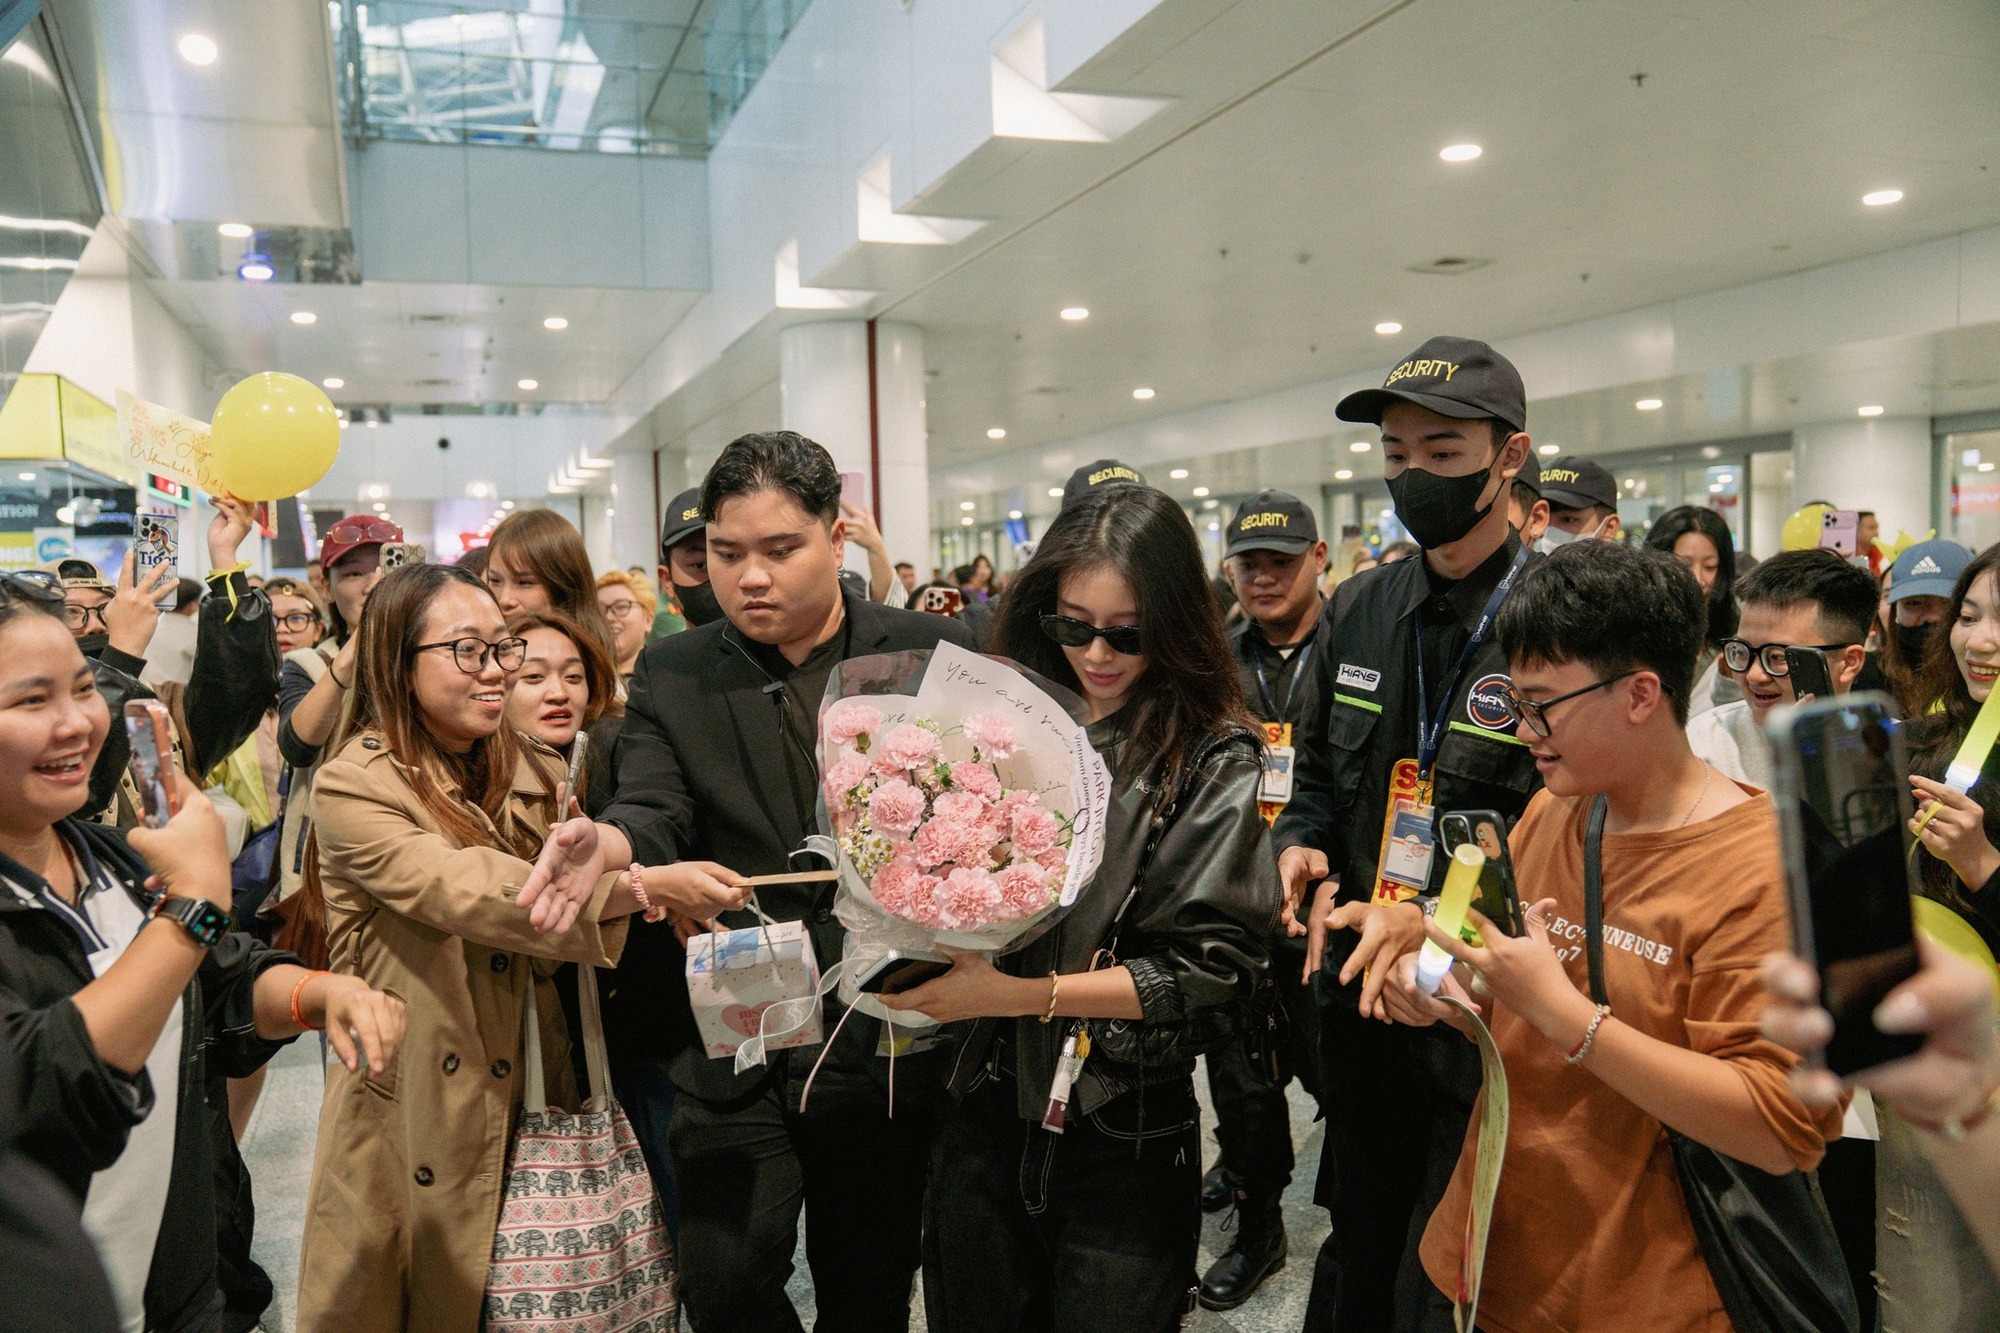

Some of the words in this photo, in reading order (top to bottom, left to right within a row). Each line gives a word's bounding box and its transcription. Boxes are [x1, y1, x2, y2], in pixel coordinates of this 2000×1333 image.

[1386, 360, 1460, 387] SECURITY
[1088, 466, 1139, 485] SECURITY
[1540, 469, 1579, 483] CURITY
[1240, 512, 1289, 531] SECURITY
[1911, 566, 1941, 576] adidas
[946, 661, 988, 685] You
[995, 689, 1033, 714] are
[1477, 702, 1507, 713] SECURITY
[1074, 733, 1087, 775] Vietnam
[1092, 760, 1106, 806] PARK
